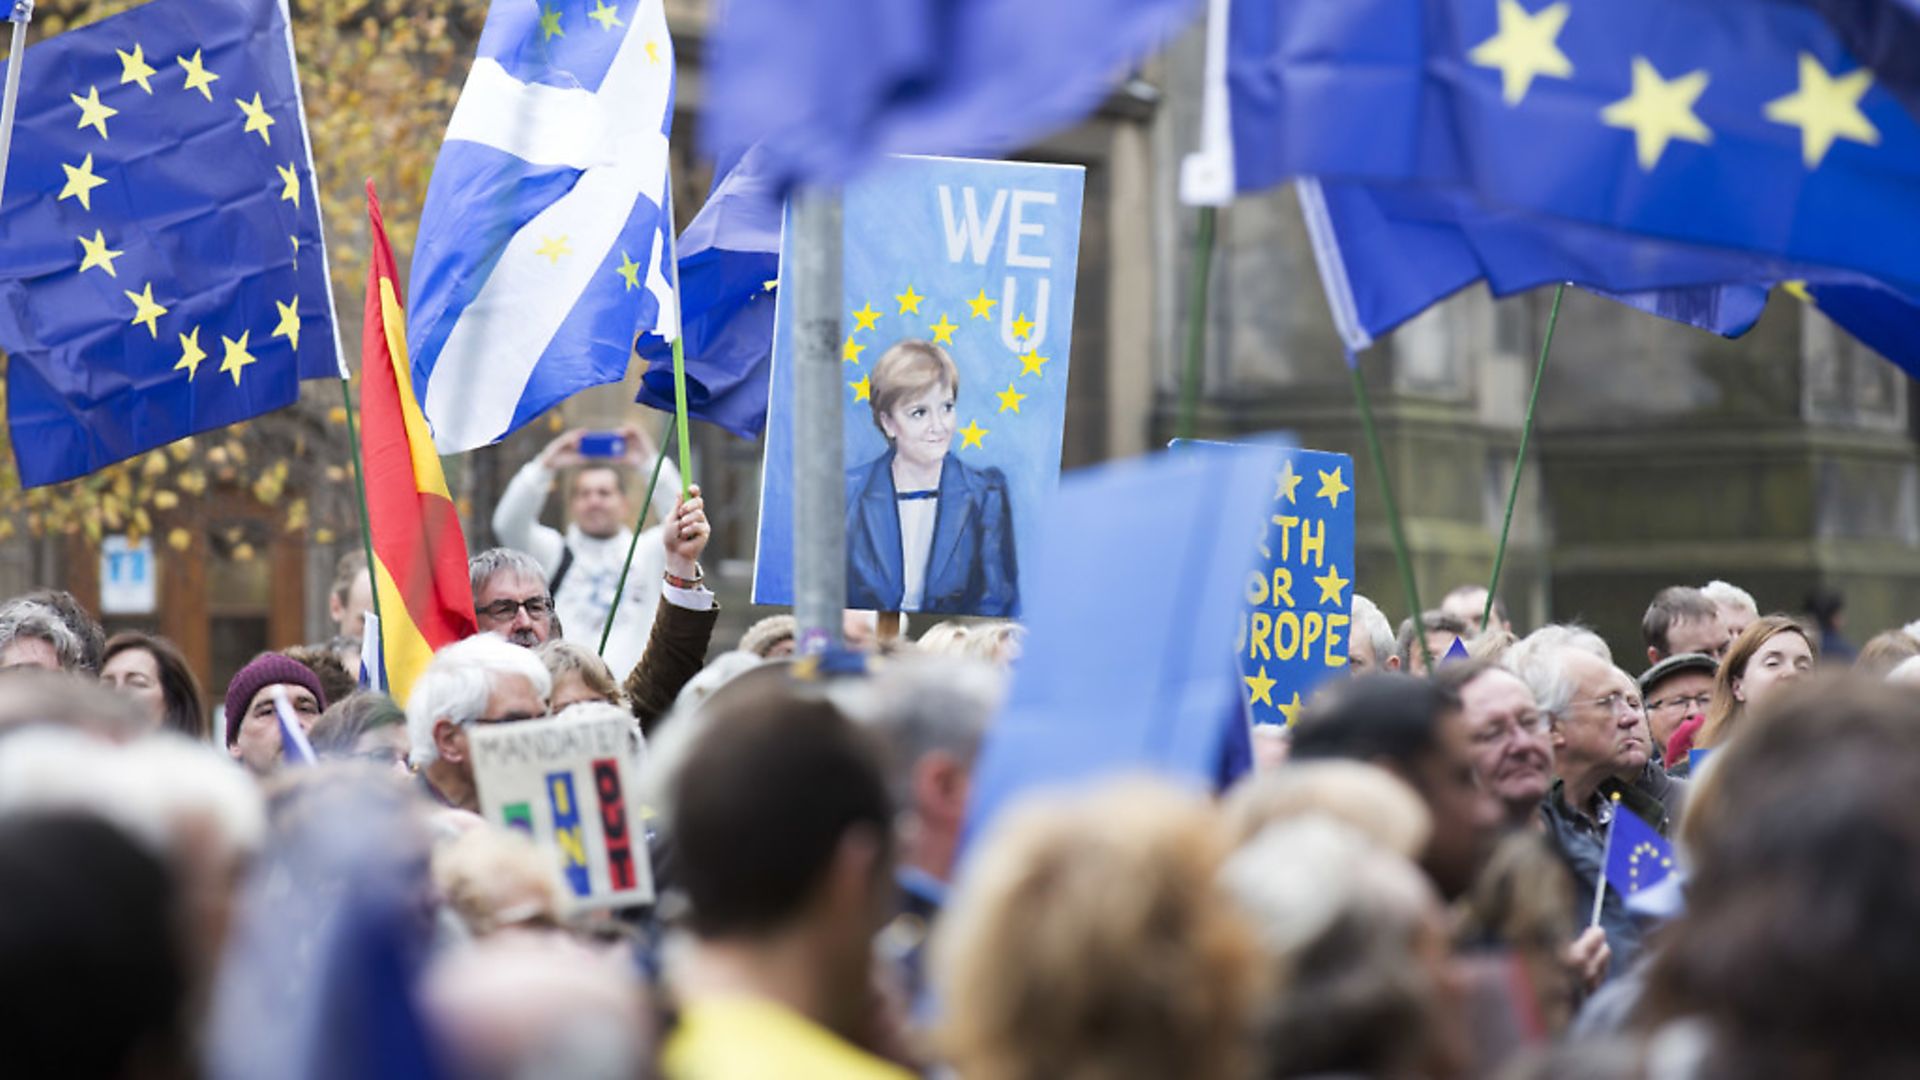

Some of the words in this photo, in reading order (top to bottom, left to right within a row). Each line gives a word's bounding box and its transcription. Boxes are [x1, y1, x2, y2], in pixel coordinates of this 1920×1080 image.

[938, 185, 1057, 268] WE
[1001, 276, 1050, 353] U
[1257, 514, 1325, 568] TH
[1245, 567, 1296, 608] OR
[1235, 611, 1349, 667] ROPE
[595, 764, 630, 888] OUT
